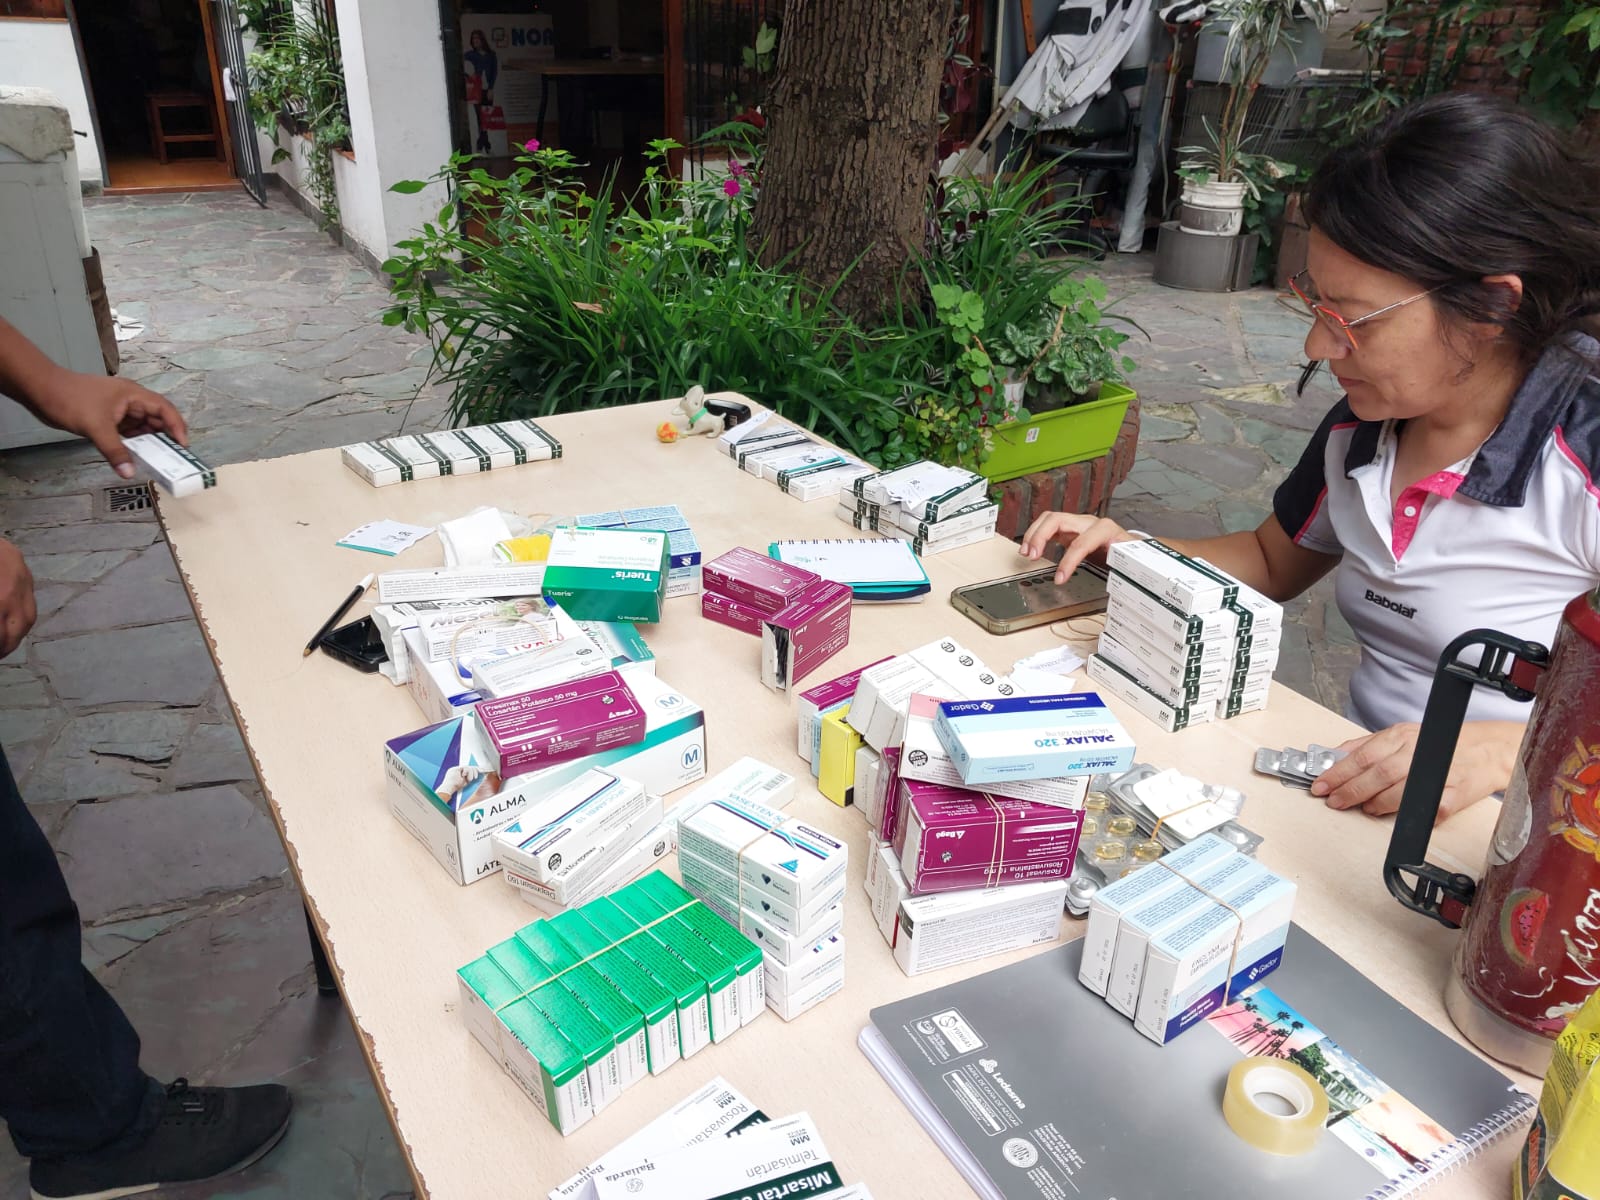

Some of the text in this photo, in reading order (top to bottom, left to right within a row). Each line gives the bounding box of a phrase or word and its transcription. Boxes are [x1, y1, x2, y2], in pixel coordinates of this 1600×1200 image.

[1365, 589, 1417, 619] Babolat
[950, 703, 980, 712] Gador
[1034, 735, 1115, 748] PALIAX 320
[490, 794, 526, 817] ALMA
[477, 859, 502, 875] LÁTE
[992, 1072, 1026, 1109] Ledesma
[790, 1134, 810, 1146] MM
[605, 1162, 655, 1182] Baliarda
[745, 1149, 820, 1178] Telmisartán
[561, 1165, 605, 1195] Baliarda
